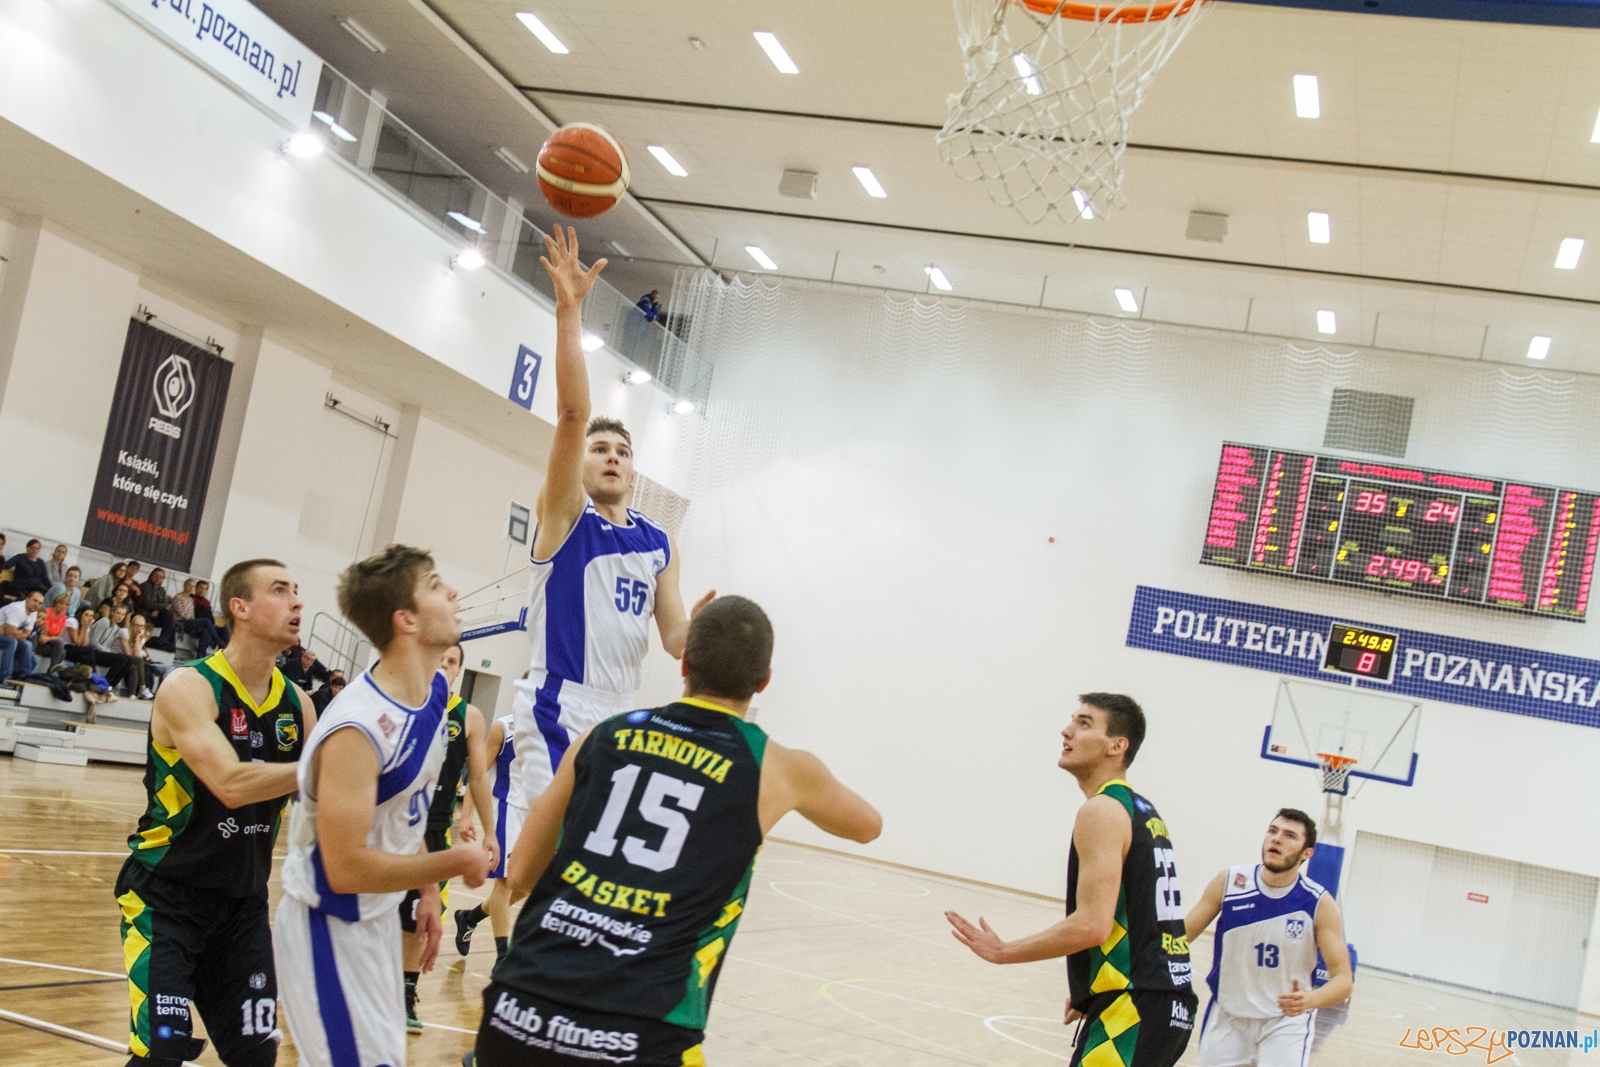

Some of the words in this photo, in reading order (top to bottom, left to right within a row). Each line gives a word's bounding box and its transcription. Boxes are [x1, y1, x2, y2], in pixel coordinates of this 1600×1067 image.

[517, 353, 538, 401] 3
[148, 416, 182, 439] REBIS
[112, 473, 142, 495] które
[143, 485, 160, 503] się
[160, 491, 189, 510] czyta
[1354, 491, 1388, 514] 35
[97, 508, 190, 545] www.rebis.com.pl
[1327, 520, 1339, 532] 2
[1395, 506, 1408, 517] 2
[1423, 502, 1460, 524] 24
[1485, 512, 1497, 524] 3
[1336, 549, 1348, 561] 2
[1480, 543, 1492, 554] 4
[1437, 564, 1449, 577] 5
[614, 576, 649, 616] 55
[1357, 652, 1376, 673] 8
[614, 729, 733, 783] TARNOVIA
[583, 763, 705, 873] 15
[560, 861, 671, 917] BASKET
[1154, 847, 1185, 922] 22
[540, 912, 600, 947] termy
[549, 897, 653, 943] tarnowskie
[1254, 942, 1280, 968] 13
[241, 998, 277, 1036] 10
[493, 992, 543, 1033] klub
[546, 1015, 639, 1051] fitness
